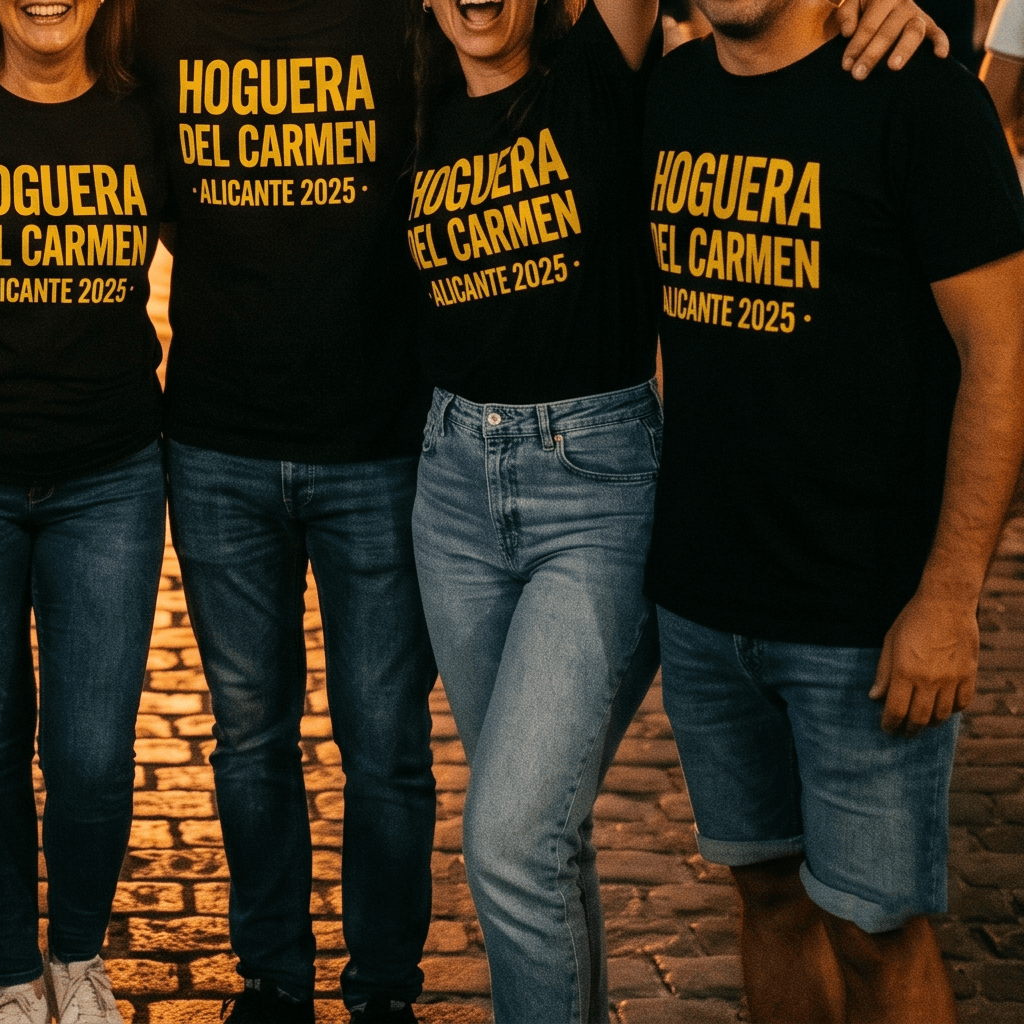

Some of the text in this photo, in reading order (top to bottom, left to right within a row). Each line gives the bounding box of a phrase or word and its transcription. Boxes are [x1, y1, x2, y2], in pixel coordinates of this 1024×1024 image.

[179, 55, 375, 115] HOGUERA
[179, 120, 376, 168] DEL CARMEN
[200, 177, 356, 206] ALICANTE 2025
[408, 128, 569, 221] HOGUERA
[650, 150, 822, 229] HOGUERA
[21, 224, 148, 267] CARMEN
[447, 189, 582, 262] CARMEN
[431, 253, 568, 307] ALICANTE 2025
[688, 227, 820, 289] CARMEN
[77, 277, 128, 304] 2025
[663, 285, 795, 334] ALICANTE 2025
